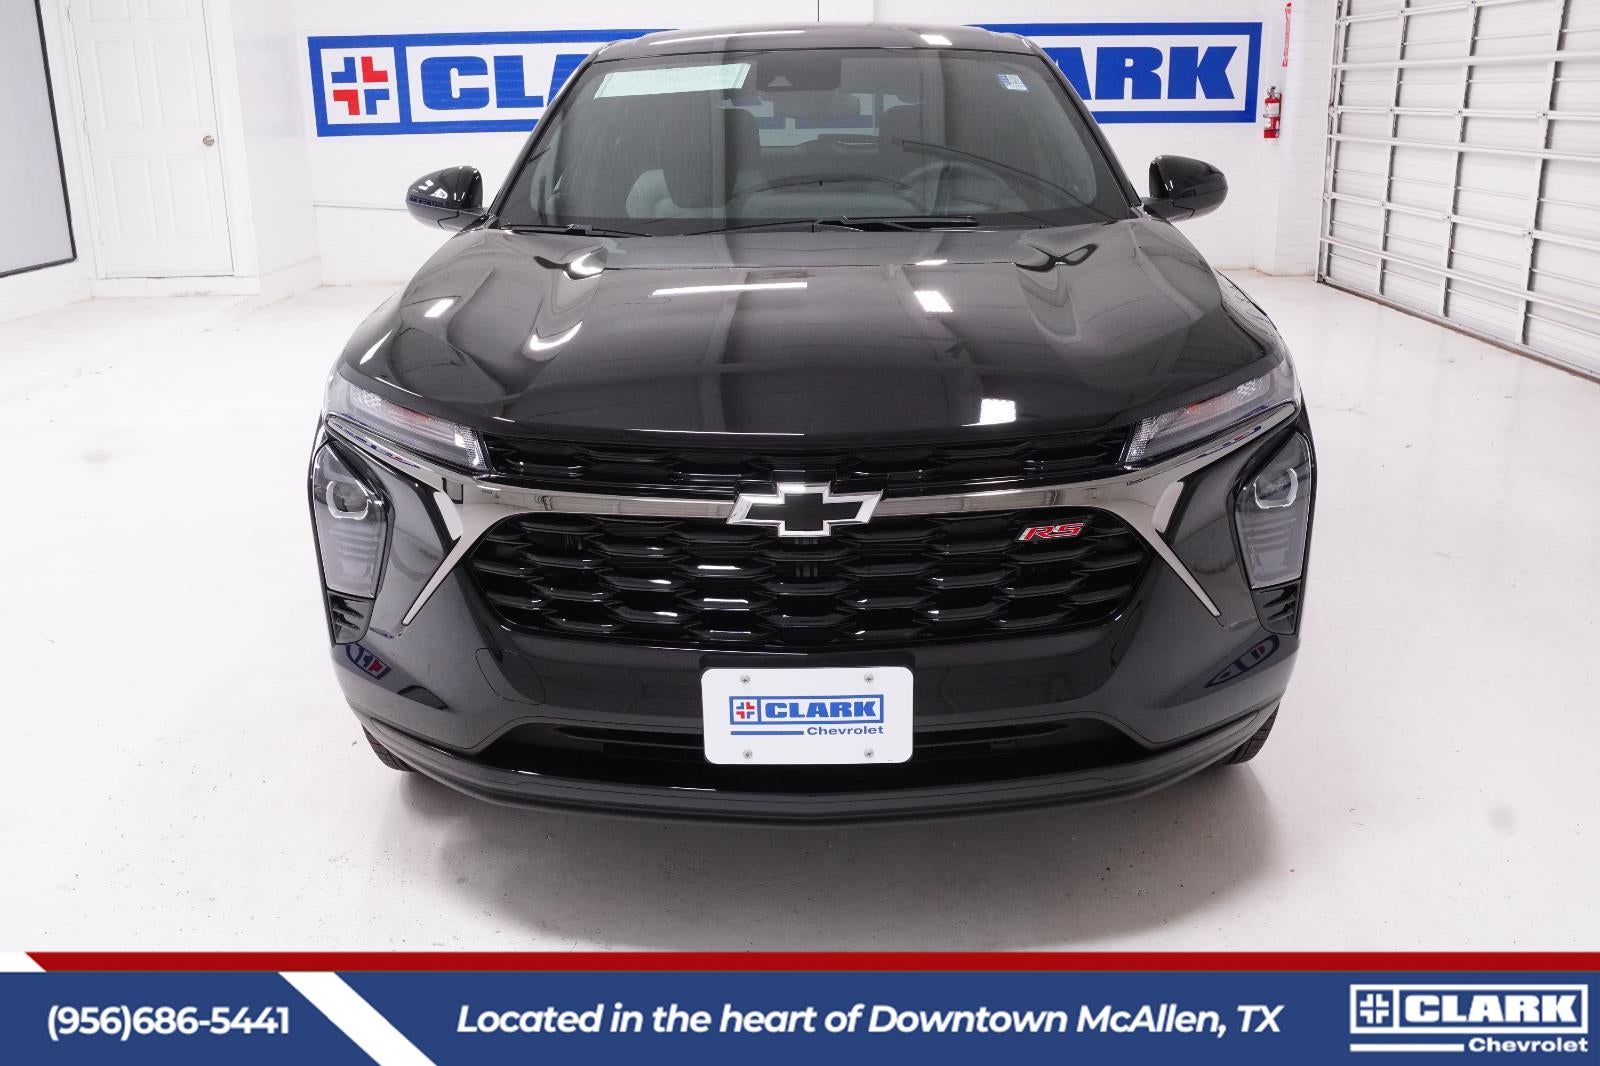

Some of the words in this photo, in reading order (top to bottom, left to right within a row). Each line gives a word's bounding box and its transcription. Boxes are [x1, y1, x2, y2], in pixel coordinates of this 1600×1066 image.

[1018, 522, 1084, 541] RS
[764, 701, 877, 718] CLARK
[806, 725, 884, 736] Chevrolet
